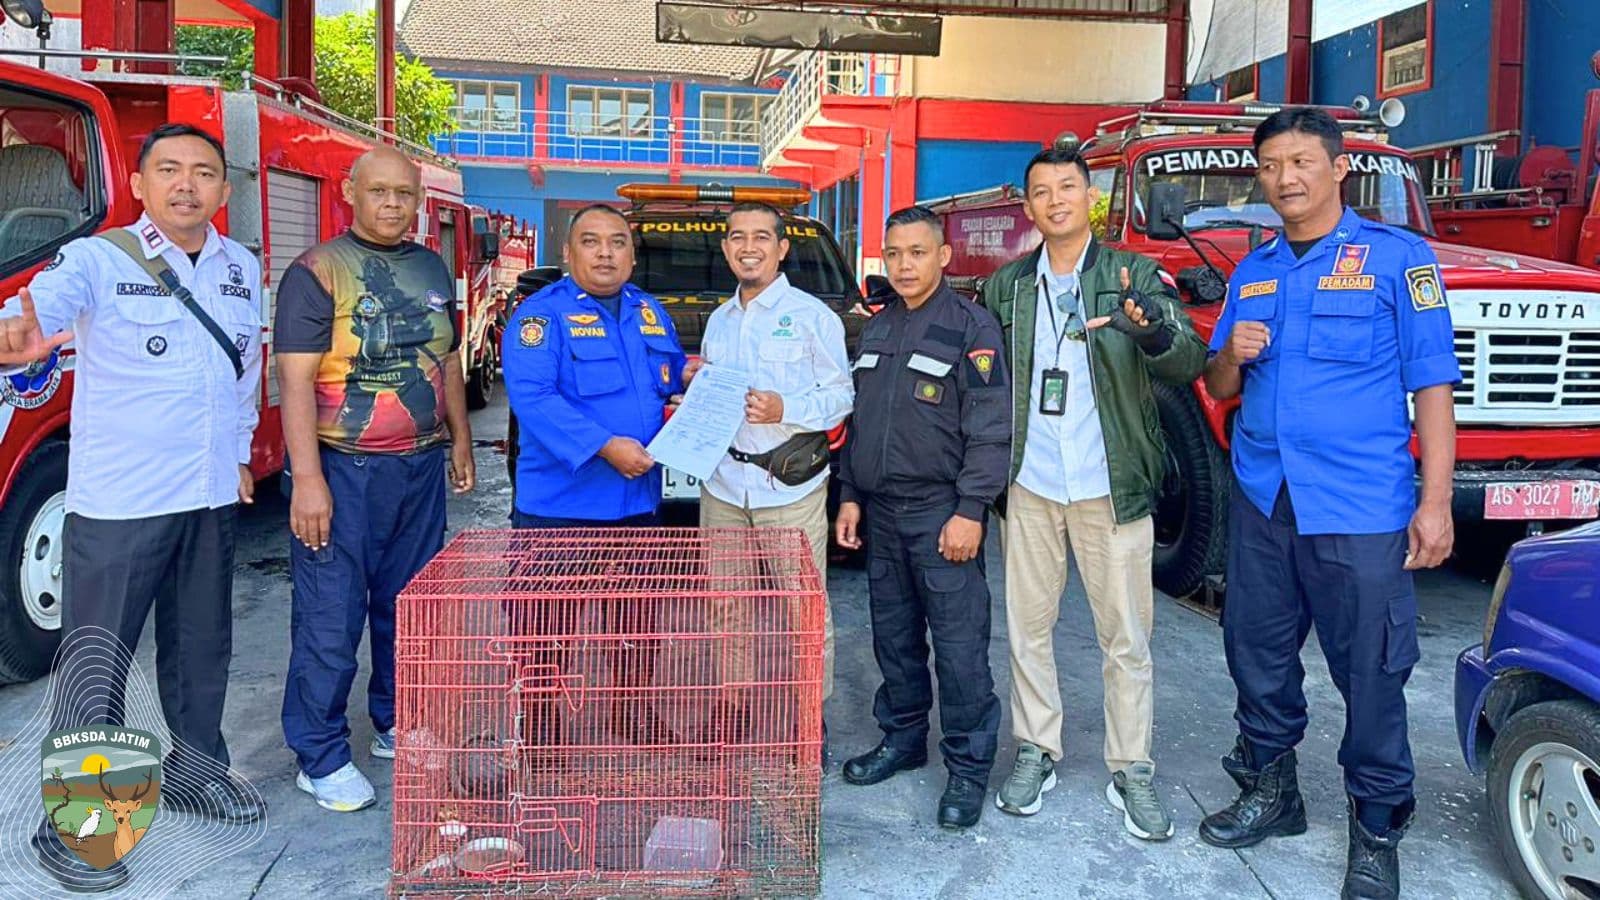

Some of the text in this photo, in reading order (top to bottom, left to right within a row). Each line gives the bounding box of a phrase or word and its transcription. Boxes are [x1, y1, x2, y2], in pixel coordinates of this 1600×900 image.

[1146, 149, 1420, 185] PEMADA KARAN
[642, 222, 818, 238] POLHUT ILE
[1321, 277, 1371, 289] PEMADAM
[1479, 302, 1585, 319] TOYOTA
[570, 327, 606, 337] NOVAN
[1492, 487, 1513, 505] AG
[1523, 484, 1561, 506] 3027
